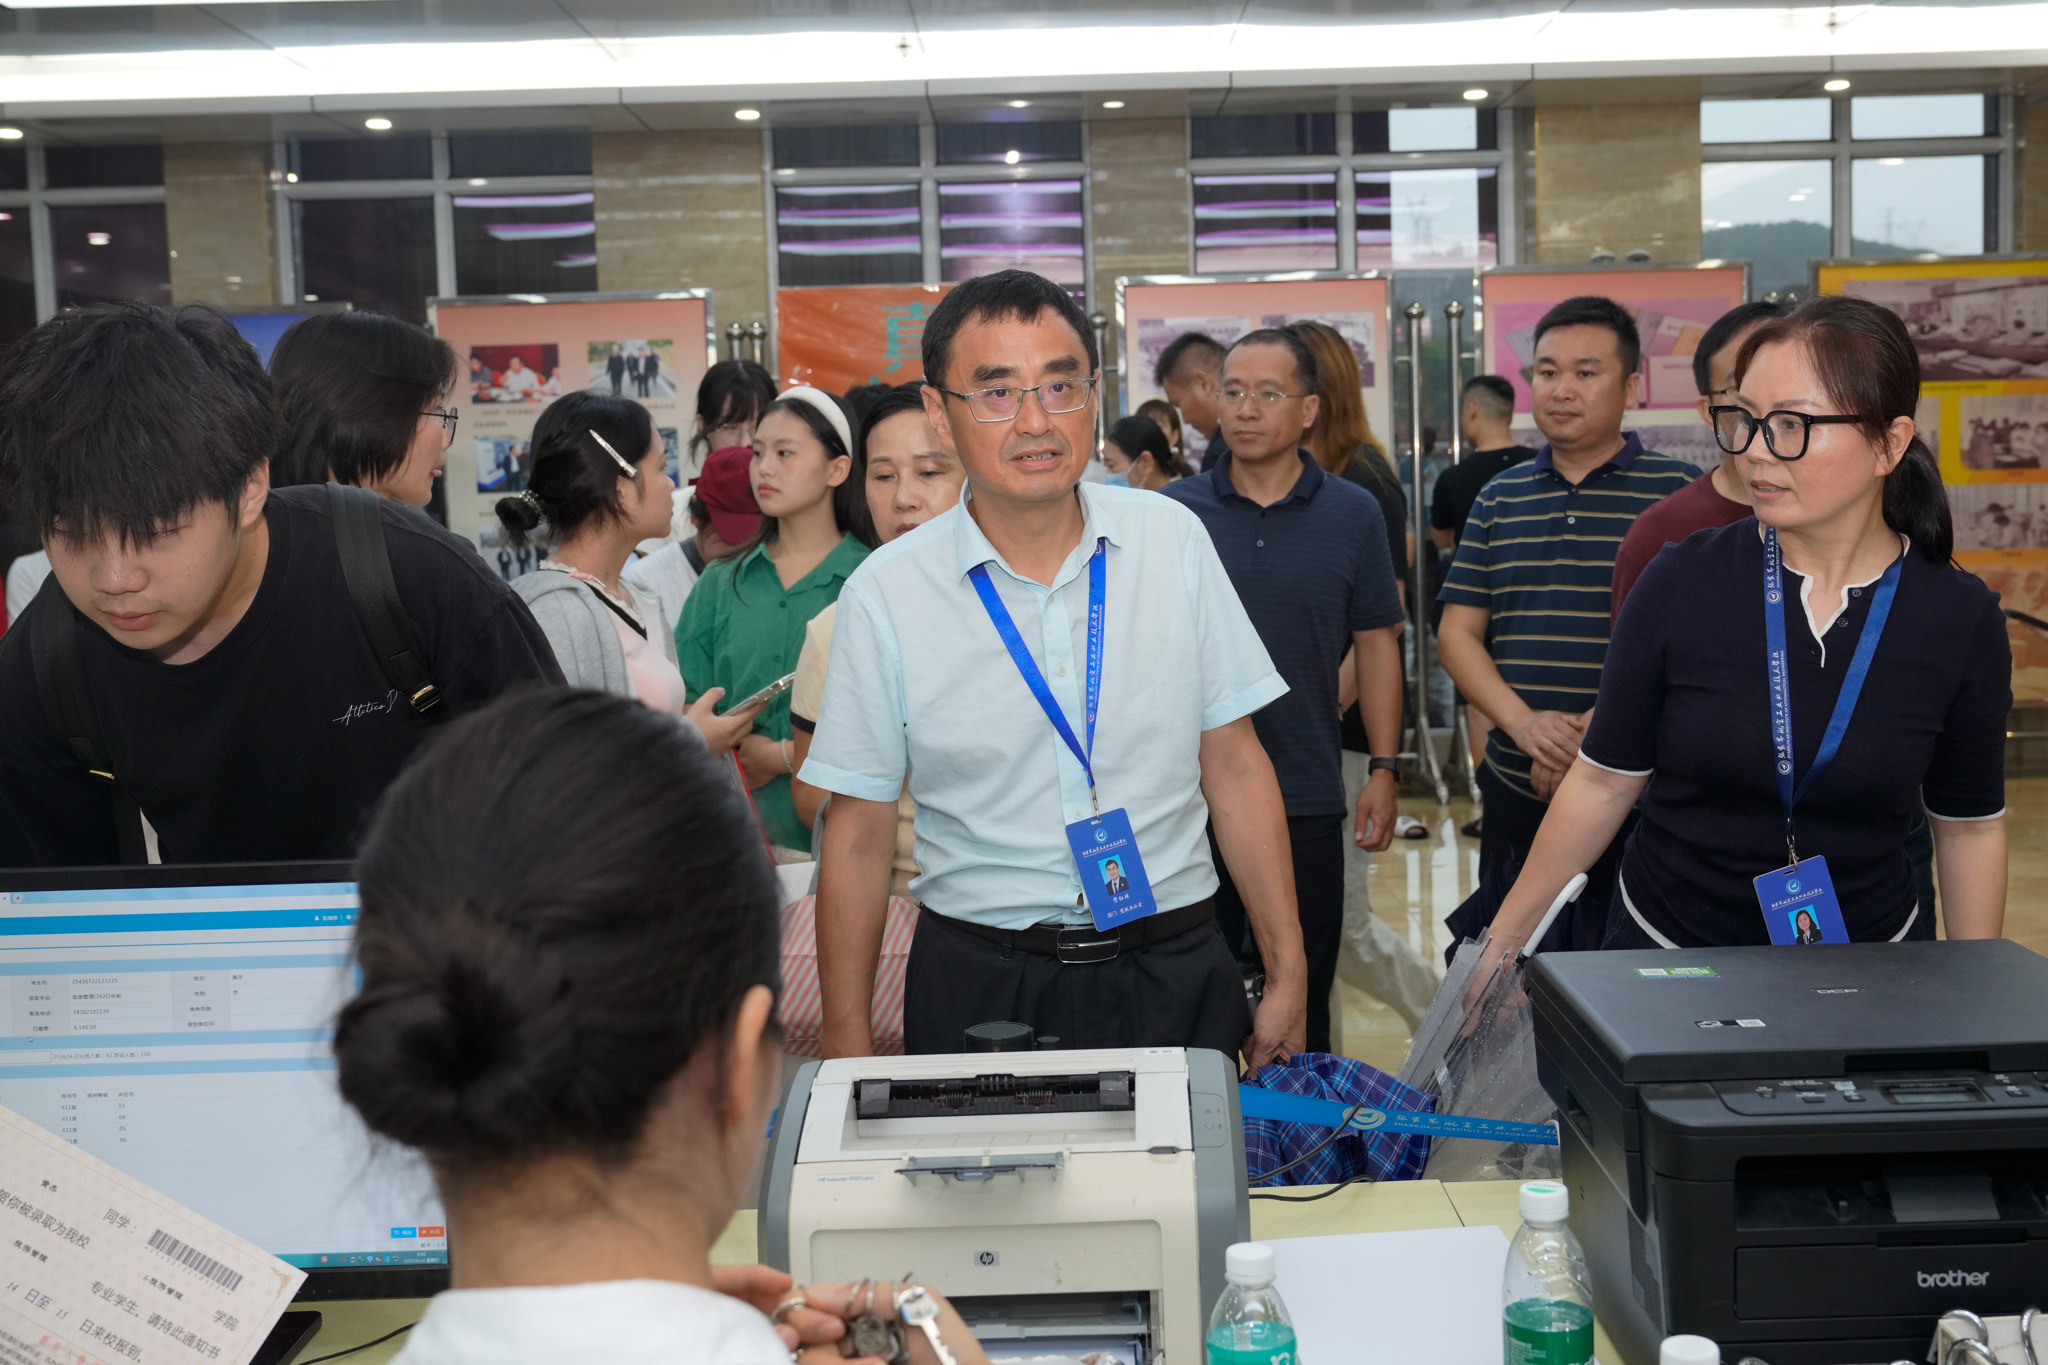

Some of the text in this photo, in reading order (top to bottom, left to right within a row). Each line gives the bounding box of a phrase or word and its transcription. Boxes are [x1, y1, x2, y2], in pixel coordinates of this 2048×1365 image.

[1443, 1126, 1480, 1134] INSTITUTE
[1917, 1270, 1990, 1288] brother
[24, 1288, 53, 1311] 日至
[212, 1309, 240, 1331] 学院
